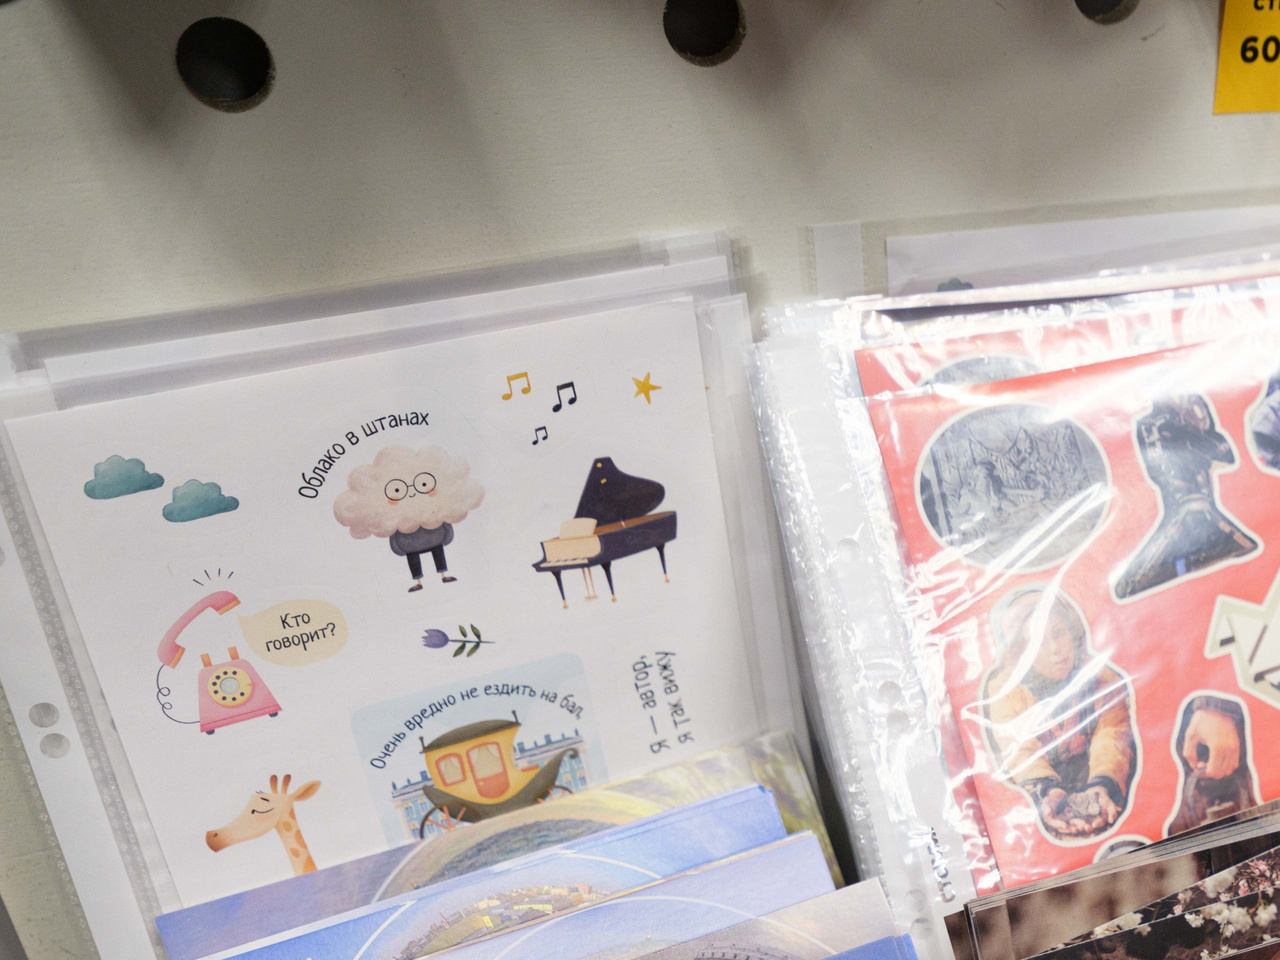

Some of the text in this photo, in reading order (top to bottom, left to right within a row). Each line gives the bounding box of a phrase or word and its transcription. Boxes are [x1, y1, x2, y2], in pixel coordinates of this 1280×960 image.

[1240, 35, 1280, 64] 60
[298, 411, 430, 499] Облако в штанах
[265, 622, 336, 652] говорит?
[280, 612, 311, 630] Кто
[632, 655, 657, 710] автор,
[655, 651, 679, 695] вижу
[369, 731, 407, 770] Очень
[404, 693, 457, 732] вредно
[460, 686, 479, 702] не
[483, 683, 538, 698] ездить
[539, 689, 558, 704] на
[667, 698, 691, 730] так
[649, 738, 671, 754] Я
